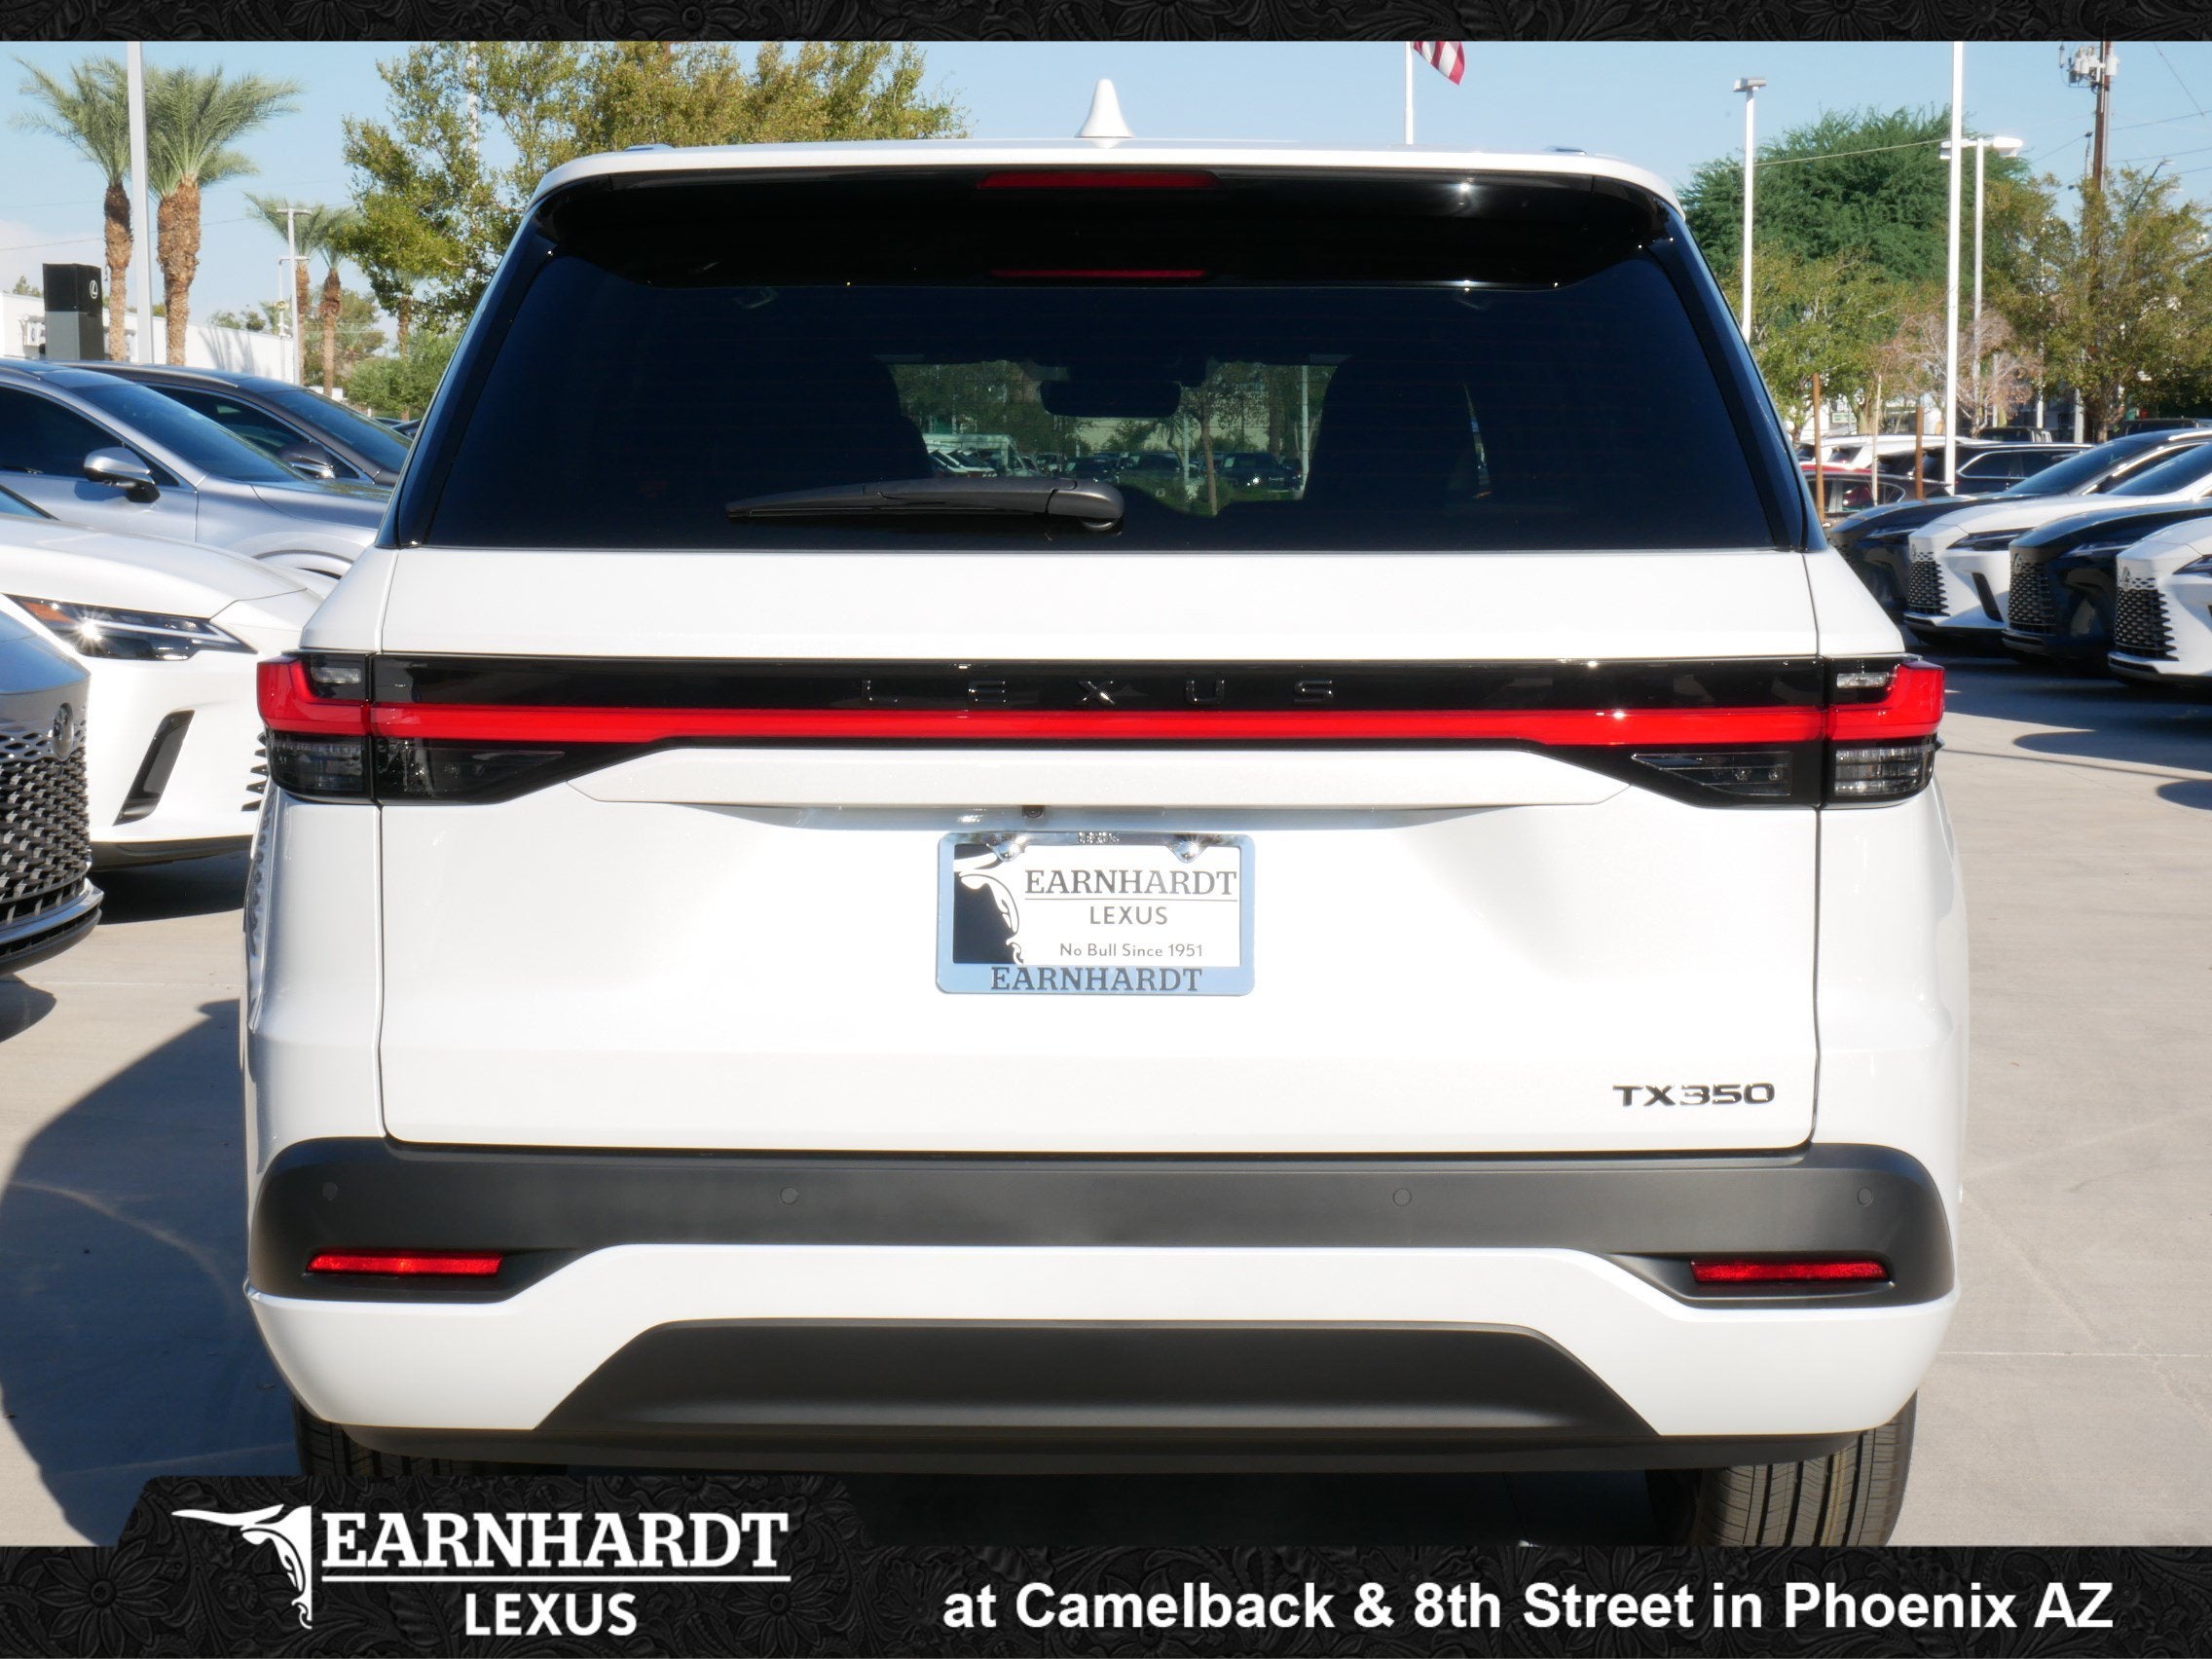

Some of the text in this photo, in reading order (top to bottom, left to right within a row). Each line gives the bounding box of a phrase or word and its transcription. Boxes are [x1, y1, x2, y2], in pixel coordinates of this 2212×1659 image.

[862, 679, 1334, 705] LEXUS
[1025, 869, 1237, 896] EARNHARDT
[1089, 905, 1168, 925] LEXUS
[1059, 942, 1202, 957] No Bull Since 1951
[990, 966, 1202, 991] EARNHARDT
